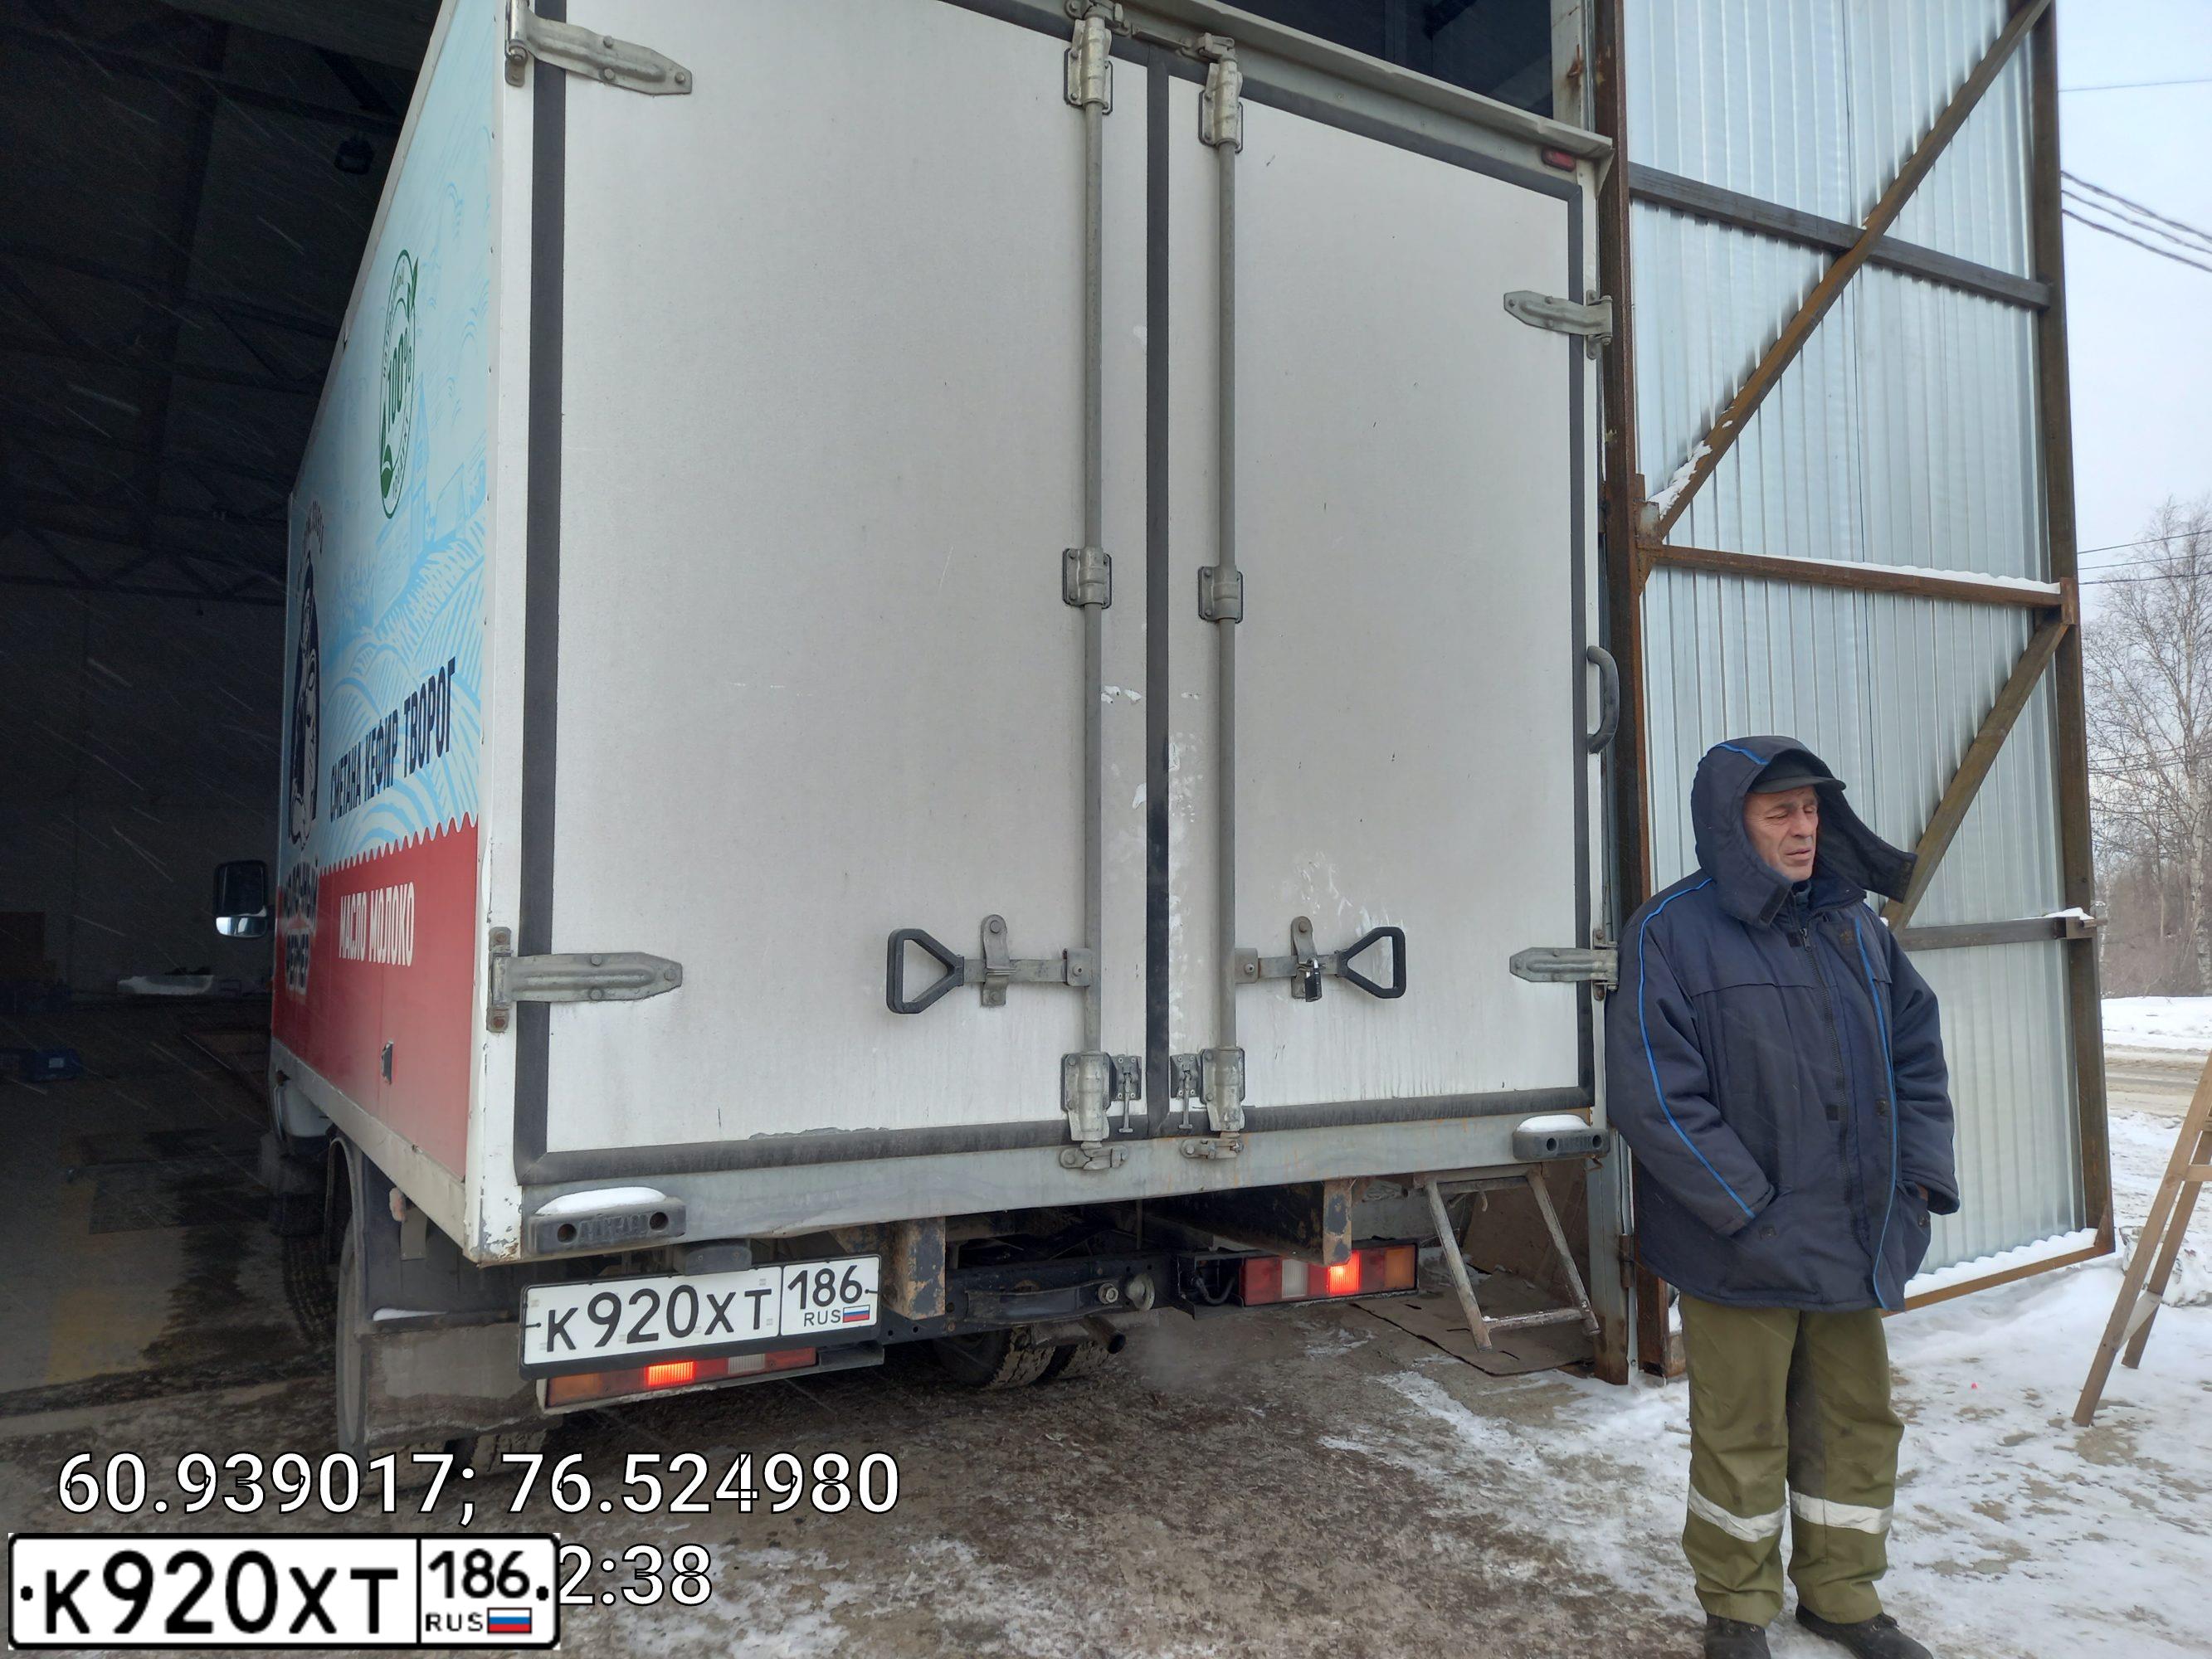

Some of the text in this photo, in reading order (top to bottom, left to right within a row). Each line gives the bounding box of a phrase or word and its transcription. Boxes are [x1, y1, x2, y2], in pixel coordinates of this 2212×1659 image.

[387, 327, 412, 433] 100%
[329, 656, 456, 823] СМЕТАНА КЕФИР ТВОРОГ
[339, 891, 368, 962] МАСЛО
[368, 881, 415, 967] МОЛОКО
[545, 1264, 863, 1354] К920ХТ 186
[803, 1308, 841, 1327] RUS
